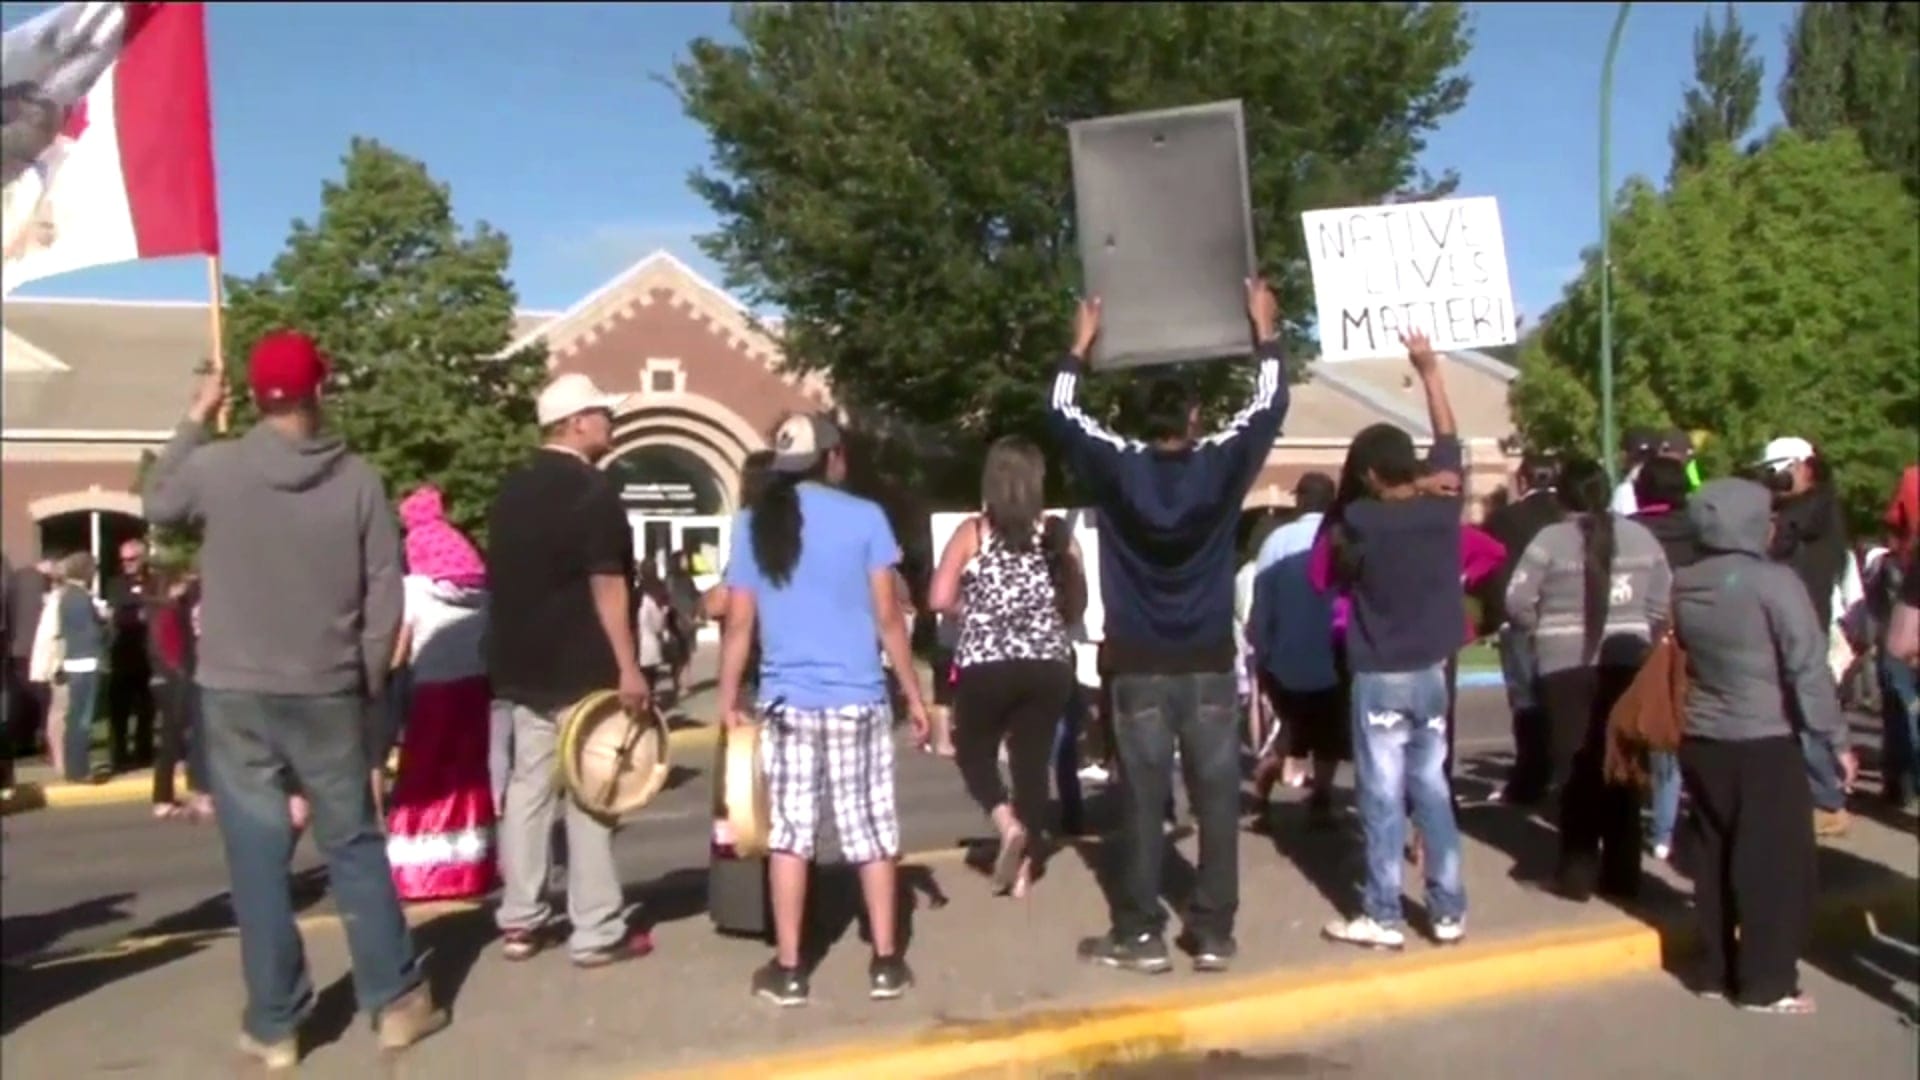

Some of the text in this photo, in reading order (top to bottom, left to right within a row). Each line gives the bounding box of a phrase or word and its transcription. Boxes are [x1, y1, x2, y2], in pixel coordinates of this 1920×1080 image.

[1319, 207, 1480, 258] NATIVE
[1366, 251, 1488, 294] LIVES
[1342, 298, 1508, 350] MATTER!
